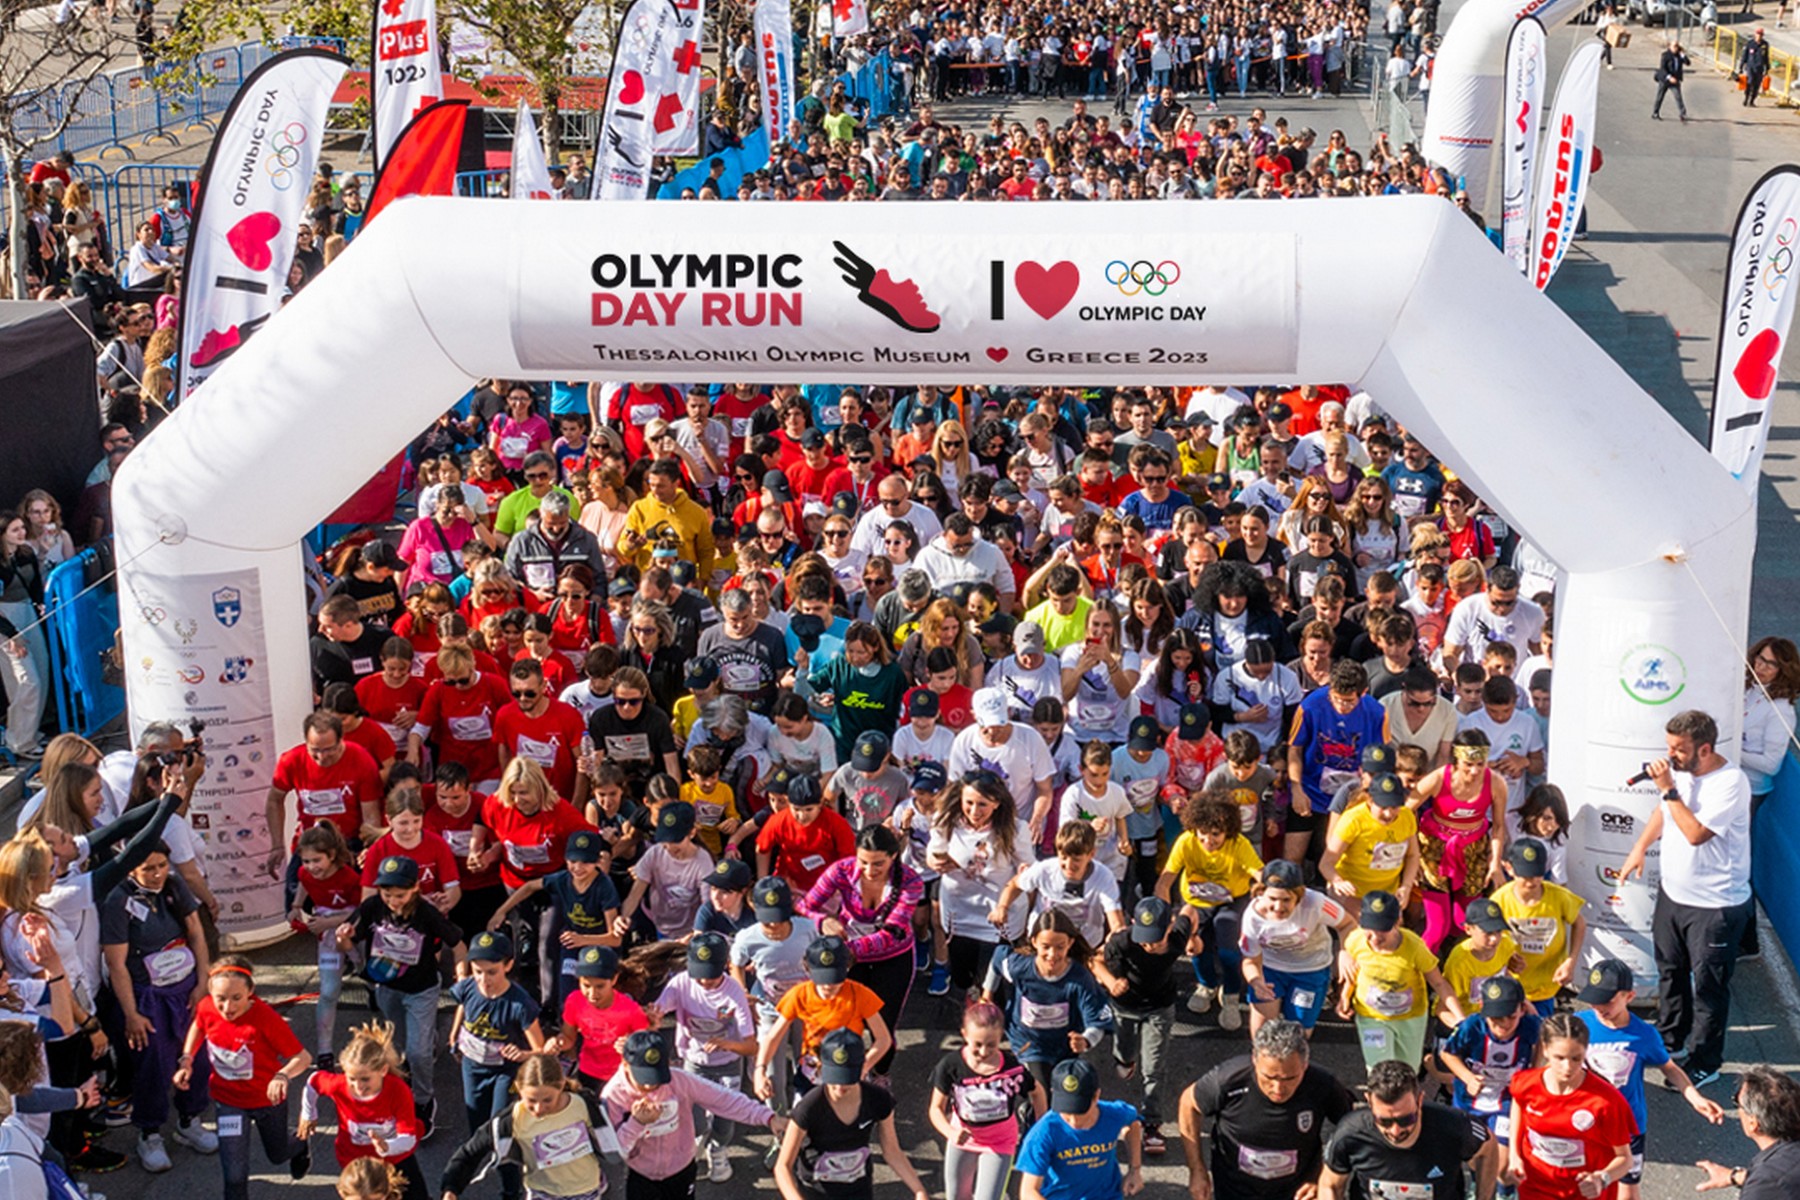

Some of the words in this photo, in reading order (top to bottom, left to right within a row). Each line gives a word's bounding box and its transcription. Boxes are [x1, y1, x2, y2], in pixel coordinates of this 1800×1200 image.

[381, 30, 425, 54] Plus
[592, 254, 803, 288] OLYMPIC
[592, 293, 687, 327] DAY
[702, 293, 803, 327] RUN
[1079, 306, 1164, 322] OLYMPIC
[1170, 306, 1207, 321] DAY
[593, 344, 758, 363] THESSALONIKI
[766, 346, 865, 365] OLYMPIC
[873, 346, 970, 363] MUSEUM
[1026, 347, 1141, 364] GREECE
[1148, 348, 1208, 364] 2023
[1601, 812, 1634, 826] one
